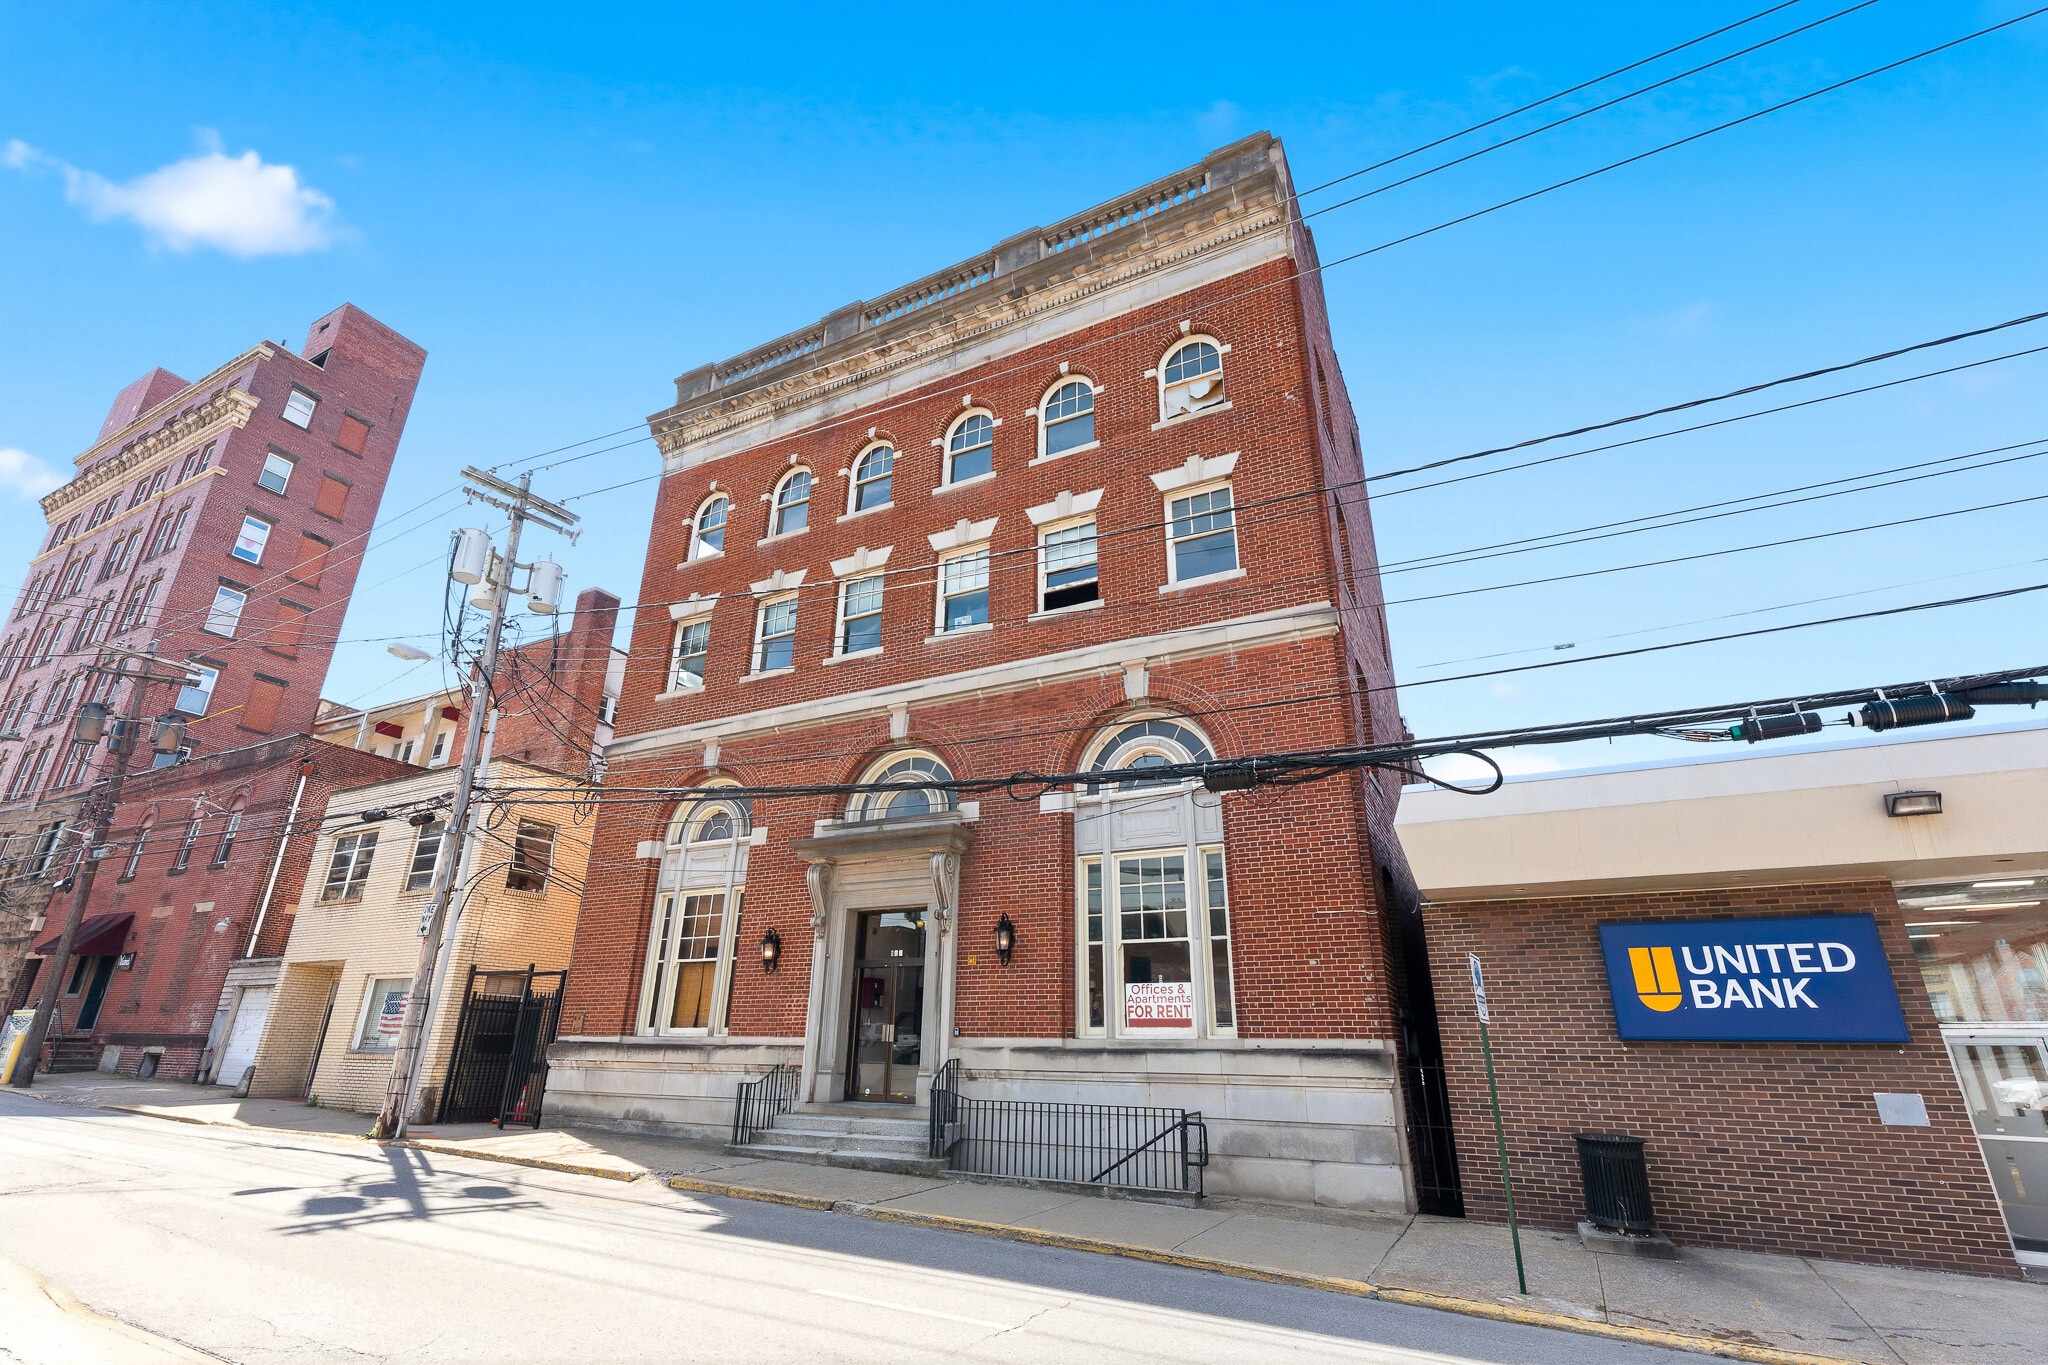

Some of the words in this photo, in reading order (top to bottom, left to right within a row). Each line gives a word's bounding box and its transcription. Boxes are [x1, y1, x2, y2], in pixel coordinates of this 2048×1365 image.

[1681, 942, 1856, 975] UNITED
[1131, 984, 1174, 994] Offices
[1177, 983, 1186, 994] &
[1689, 978, 1819, 1009] BANK
[1127, 994, 1192, 1005] Apartments
[1128, 1005, 1153, 1018] FOR
[1157, 1005, 1191, 1018] RENT
